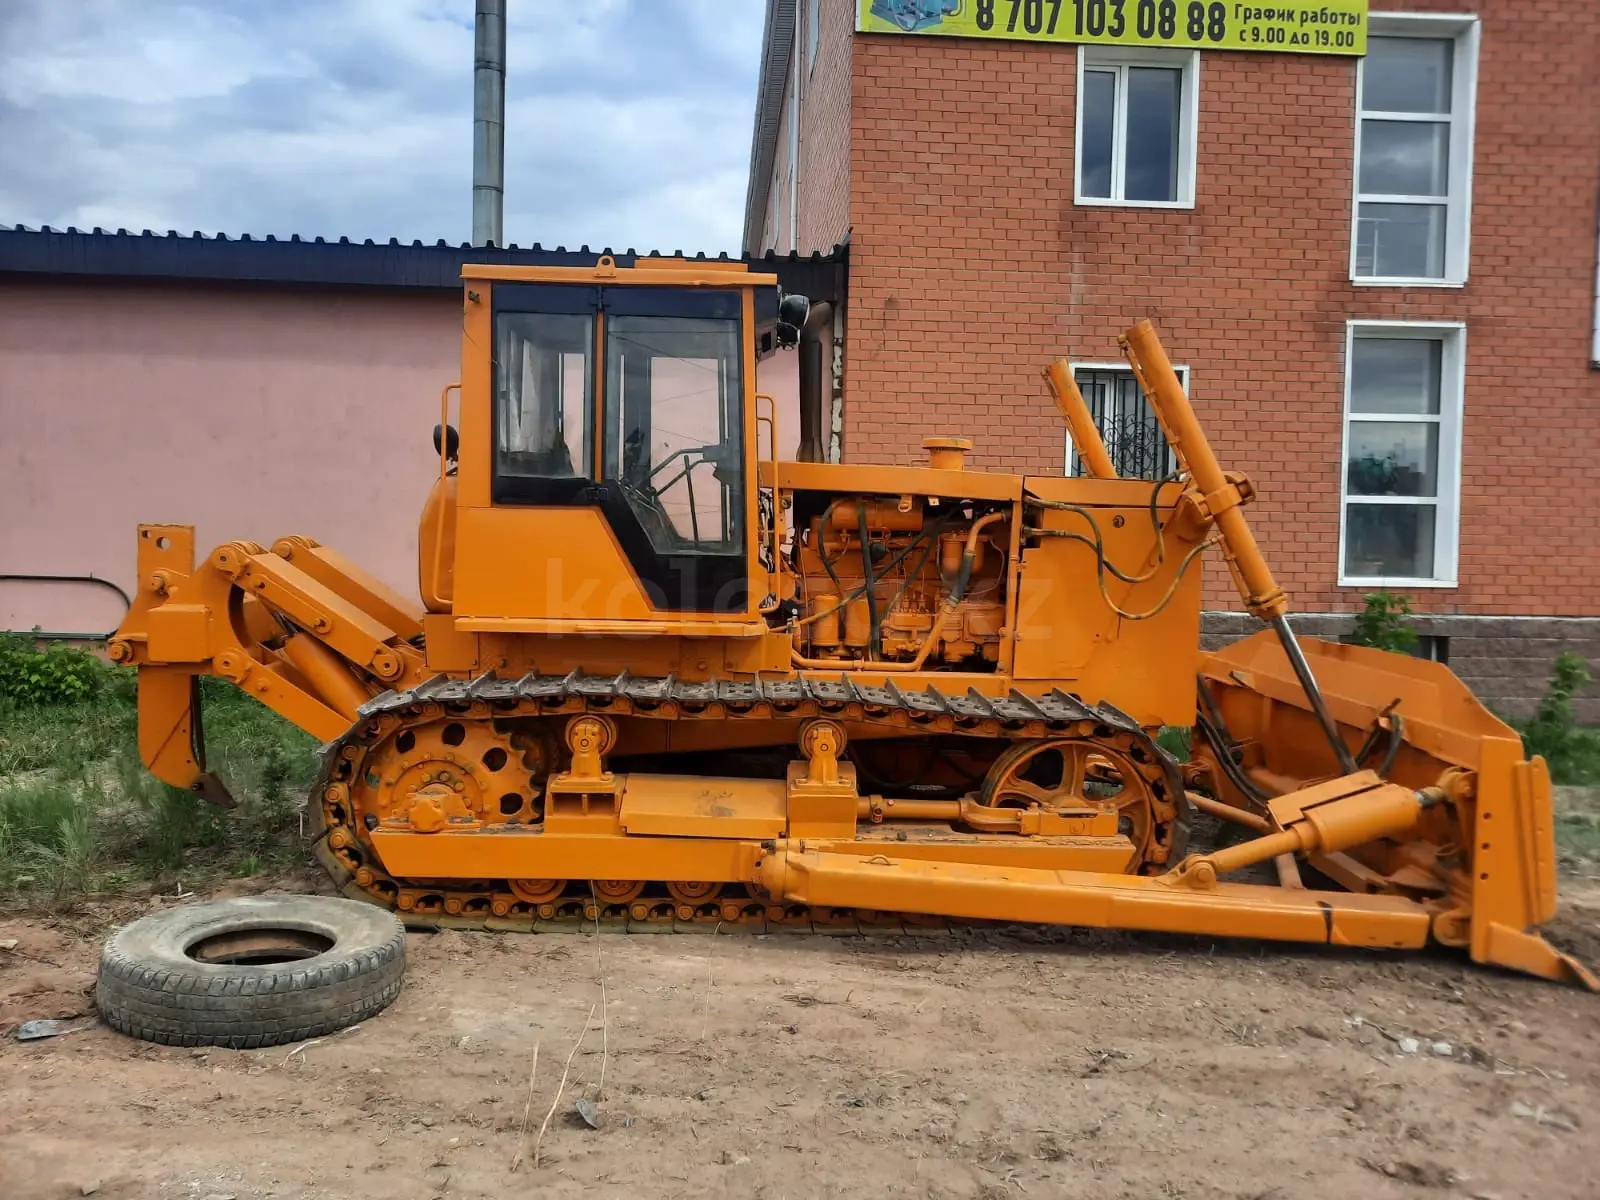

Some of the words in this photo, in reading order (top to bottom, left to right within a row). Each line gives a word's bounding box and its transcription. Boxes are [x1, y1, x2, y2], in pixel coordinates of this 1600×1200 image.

[976, 0, 995, 31] 8
[1002, 0, 1062, 34] 707
[1073, 0, 1126, 37] 103
[1136, 0, 1177, 39] 08
[1186, 1, 1226, 42] 88
[1234, 3, 1295, 24] График
[1300, 7, 1361, 27] работы
[1251, 26, 1286, 44] 9.00
[1289, 32, 1310, 45] до
[1314, 30, 1355, 47] 19.00
